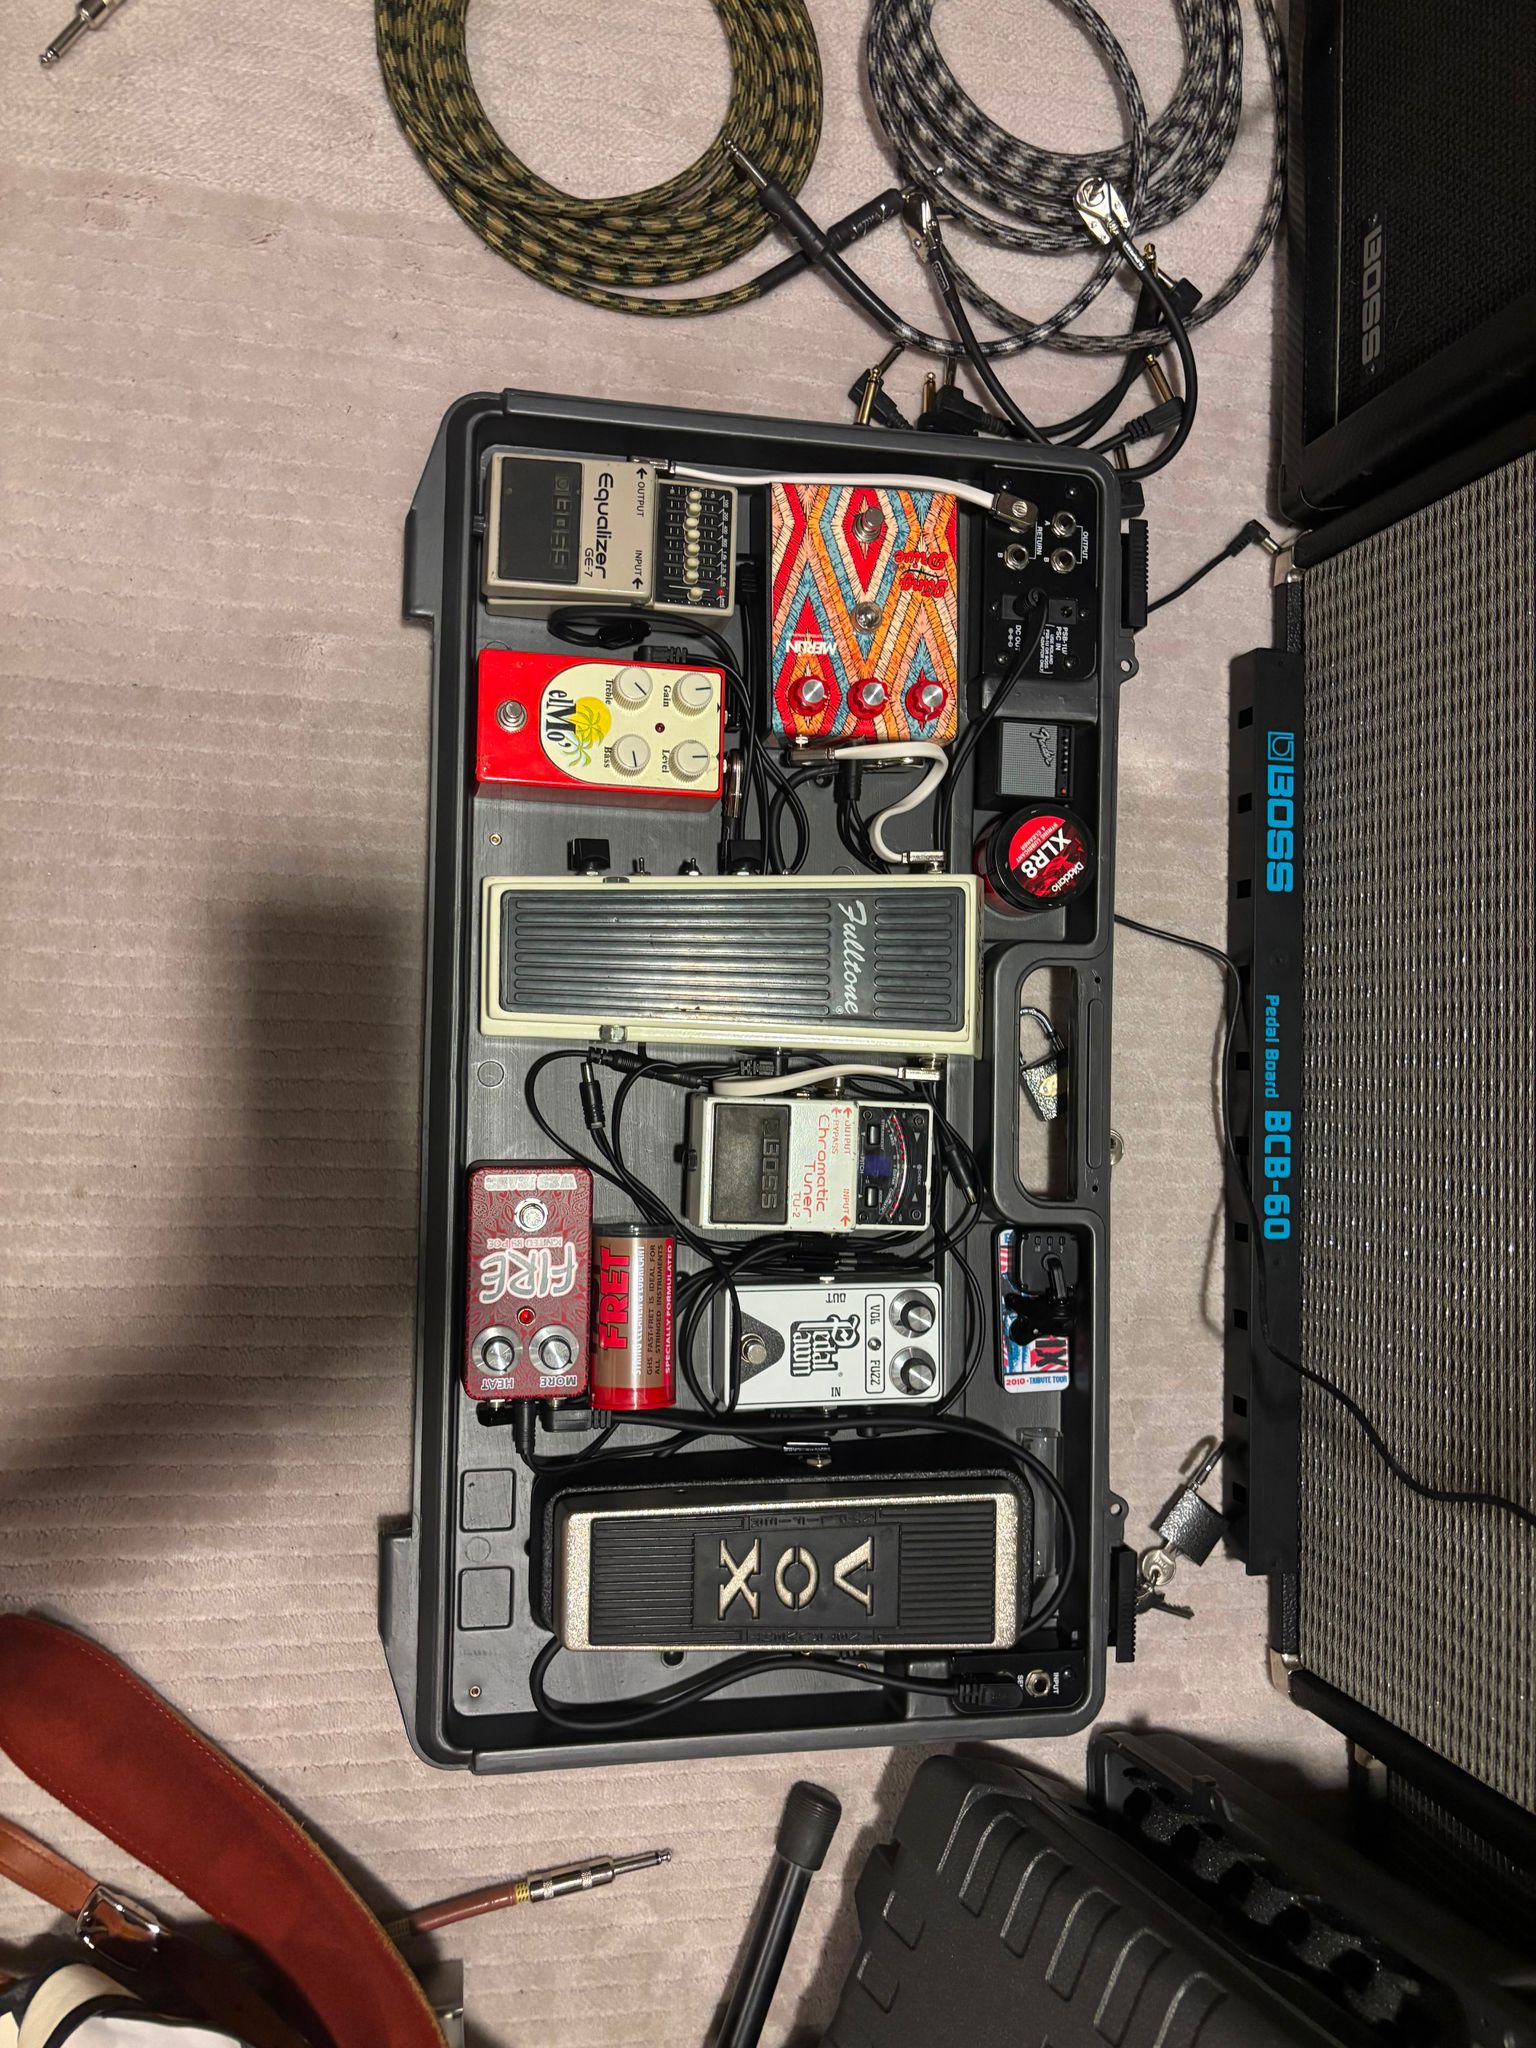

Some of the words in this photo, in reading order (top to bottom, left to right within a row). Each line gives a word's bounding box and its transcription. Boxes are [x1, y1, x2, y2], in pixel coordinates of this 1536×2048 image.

[1361, 224, 1382, 366] BOSS
[635, 481, 645, 518] OUTPUT
[593, 471, 614, 580] Equalizer
[1044, 519, 1051, 527] A
[1036, 526, 1044, 556] RETURN
[583, 547, 594, 578] GE-7
[633, 549, 643, 576] INPUT
[893, 550, 948, 570] Drive
[899, 572, 948, 599] King
[1014, 624, 1021, 635] DC
[605, 679, 614, 705] Treble
[663, 685, 672, 708] Gain
[603, 746, 612, 768] Bass
[1029, 726, 1055, 768] Fender
[661, 749, 670, 773] Level
[1019, 829, 1041, 851] CLEANER
[1266, 764, 1295, 892] BOSS
[1015, 837, 1042, 864] LUBRICANT
[1020, 827, 1072, 879] XLR8
[1051, 861, 1085, 893] D'Addario
[837, 899, 868, 1015] Fulltone
[1264, 994, 1280, 1043] Pedal
[1264, 1048, 1280, 1099] Board
[831, 1119, 840, 1155] BYPASS
[761, 1137, 780, 1210] BOSS
[815, 1114, 831, 1213] Chromatic
[1263, 1110, 1292, 1240] BCB-60
[802, 1160, 816, 1218] Tuner
[842, 1188, 850, 1214] INPUT
[791, 1190, 801, 1218] TU-2
[486, 1238, 509, 1250] POE
[525, 1237, 563, 1249] IGNITED
[479, 1242, 578, 1304] FIRE
[599, 1246, 630, 1350] FRET
[649, 1296, 655, 1304] IS
[825, 1292, 847, 1304] OUT
[870, 1304, 881, 1325] VOL
[481, 1377, 515, 1390] HEAT
[539, 1375, 578, 1387] MORE
[870, 1360, 881, 1386] FUZZ
[1005, 1377, 1026, 1386] 2010
[1029, 1376, 1052, 1385] TRIBUTE
[1052, 1375, 1068, 1383] TOUR
[831, 1386, 841, 1397] IN
[718, 1536, 875, 1621] VOX
[1052, 1671, 1060, 1695] INPUT
